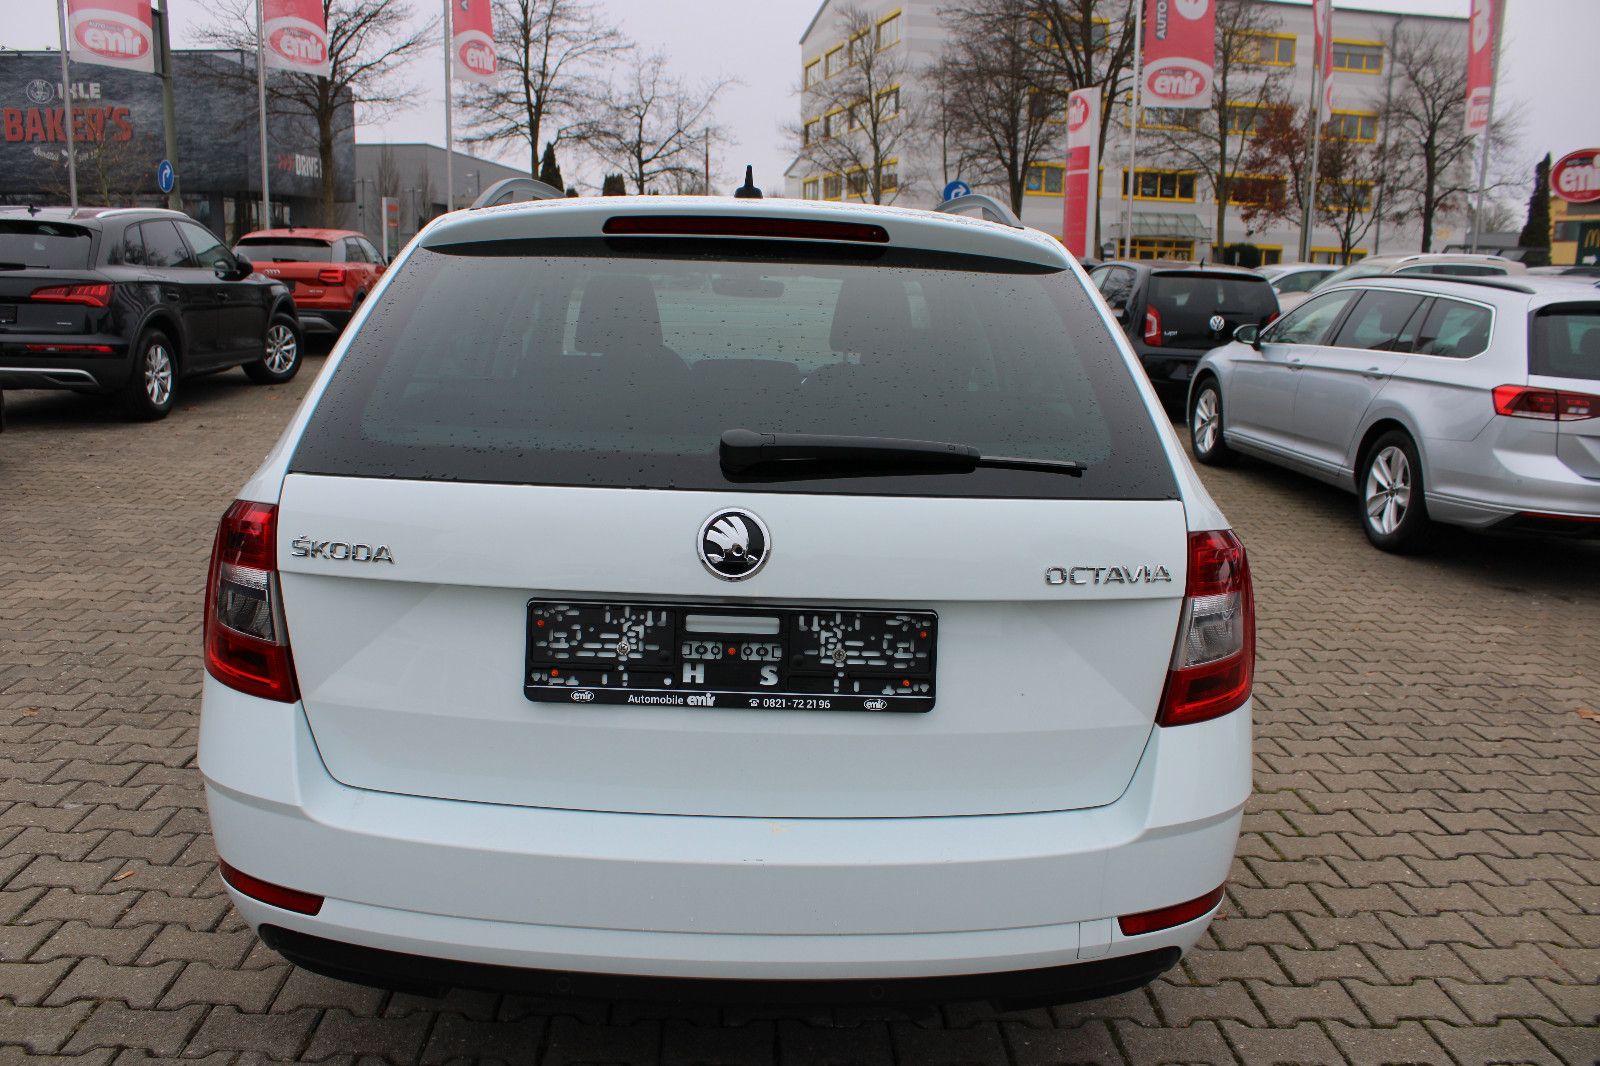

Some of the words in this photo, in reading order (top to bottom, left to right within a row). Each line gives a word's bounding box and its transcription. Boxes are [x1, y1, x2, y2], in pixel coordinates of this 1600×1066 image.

[85, 28, 141, 55] emir
[280, 34, 323, 61] emir
[466, 46, 494, 71] emir
[1154, 71, 1200, 95] emir
[3, 105, 133, 142] BAKER'S
[1559, 154, 1600, 192] emi
[291, 534, 395, 564] ŠKODA
[1045, 564, 1172, 585] OCTAVIA
[572, 690, 593, 701] emir
[627, 694, 684, 705] Automobile
[687, 692, 716, 707] emir
[864, 699, 887, 710] emir
